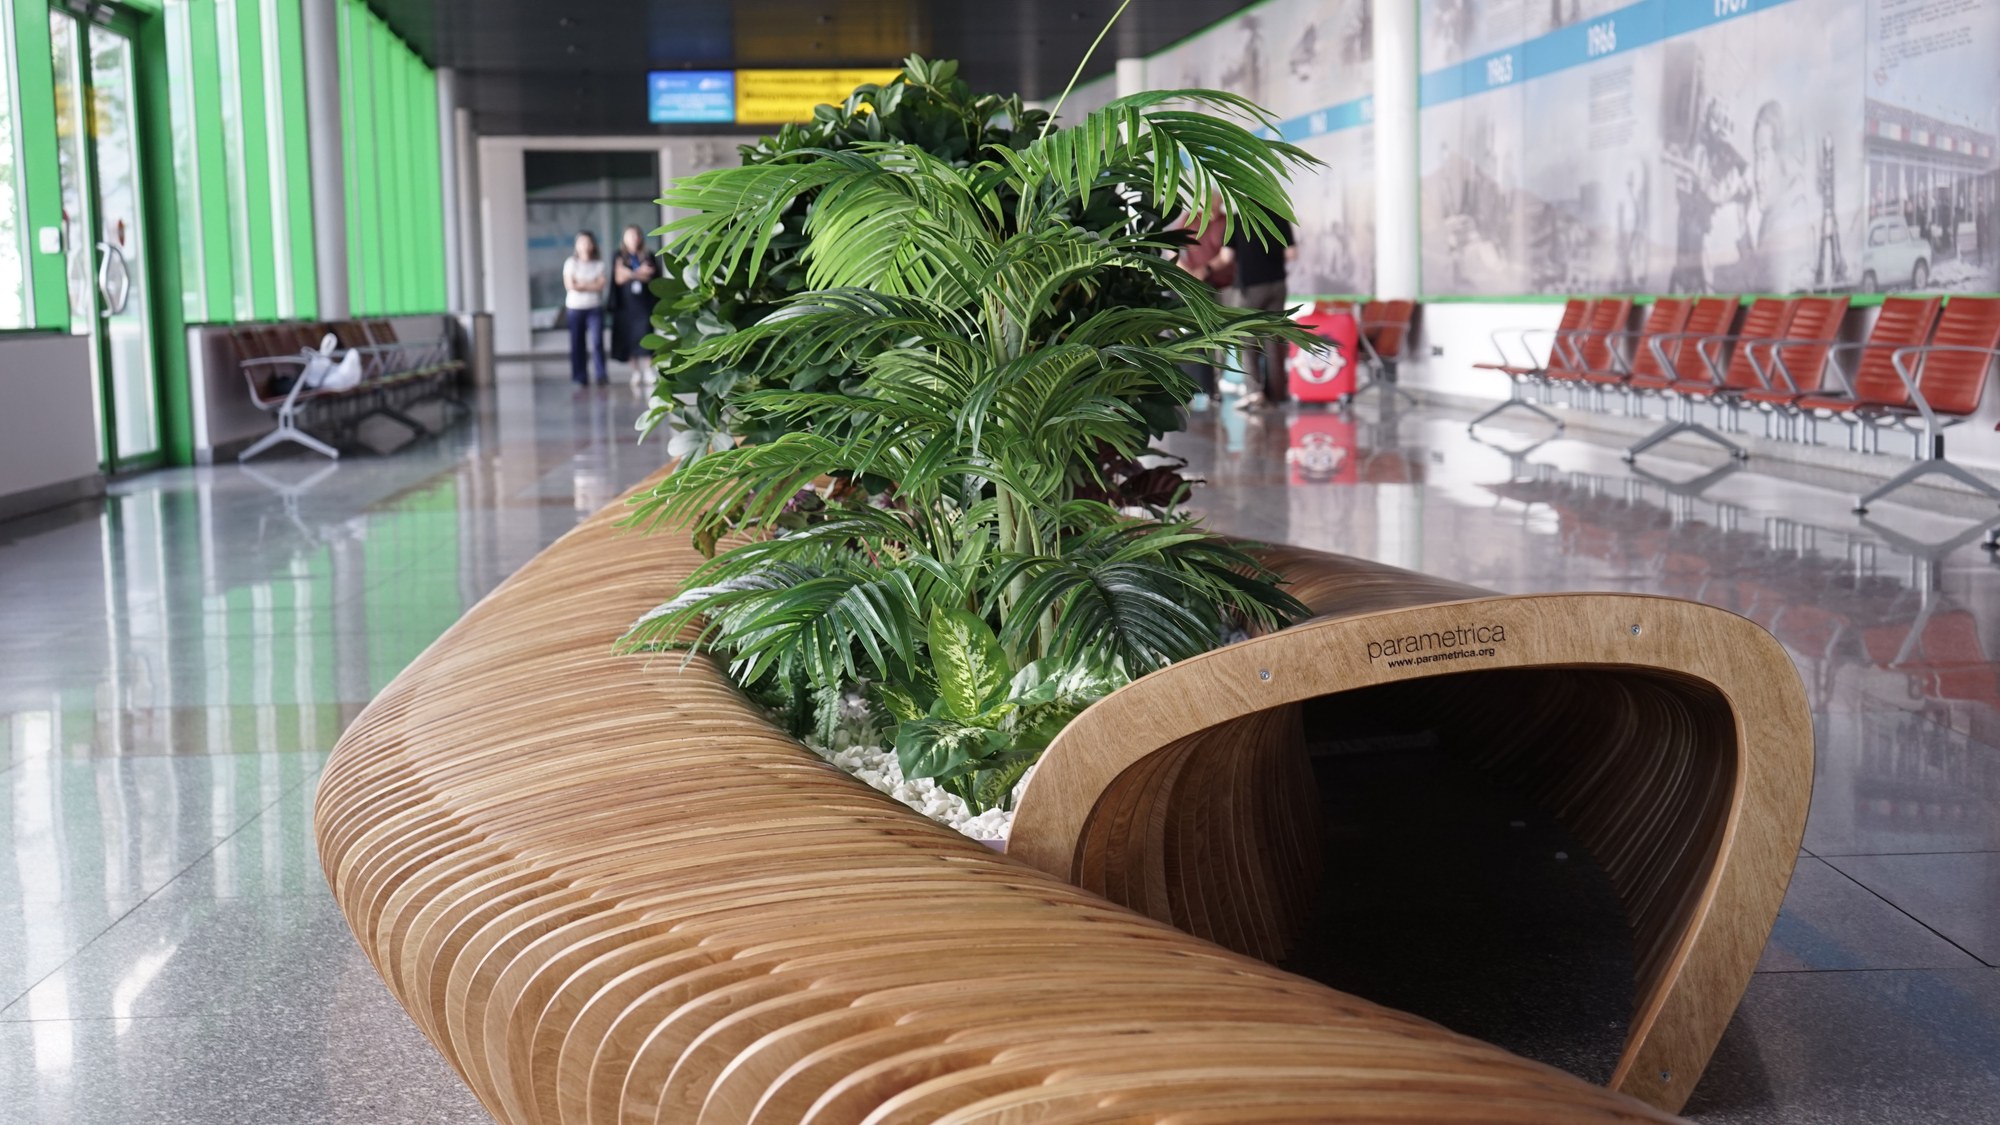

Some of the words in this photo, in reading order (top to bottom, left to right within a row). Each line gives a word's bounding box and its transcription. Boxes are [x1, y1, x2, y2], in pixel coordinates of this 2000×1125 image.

[1587, 19, 1617, 56] 1966
[1487, 54, 1513, 85] 1963
[1366, 623, 1506, 664] parametrica
[1388, 647, 1496, 668] www.parametrica.org
